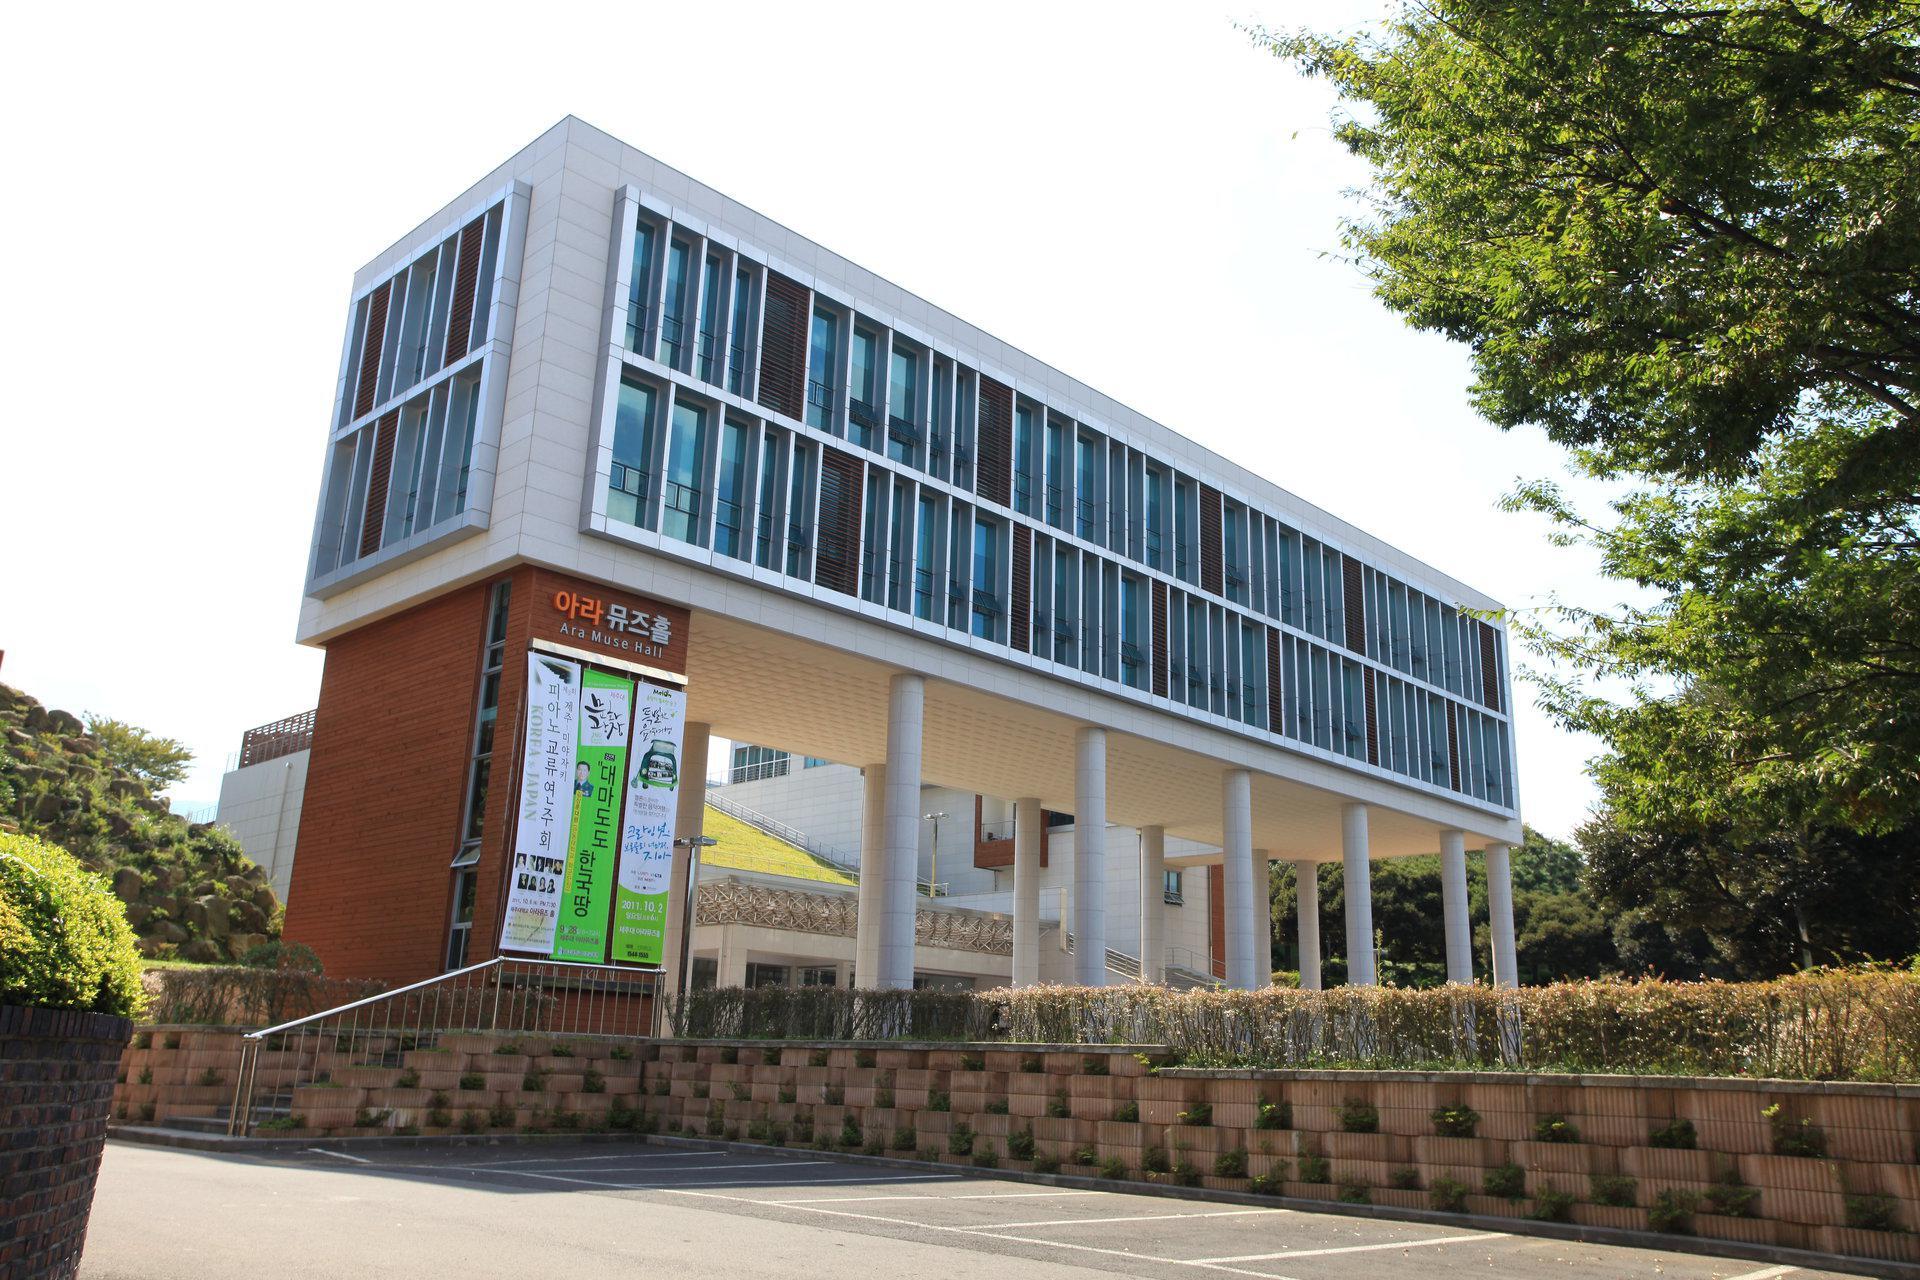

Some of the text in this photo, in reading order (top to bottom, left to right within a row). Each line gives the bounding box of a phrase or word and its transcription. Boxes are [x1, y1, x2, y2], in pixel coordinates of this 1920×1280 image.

[555, 591, 672, 645] 아라 뮤즈홀
[560, 622, 662, 658] Ara Muse Hall
[529, 705, 544, 757] KOREA
[525, 770, 540, 821] JAPAN
